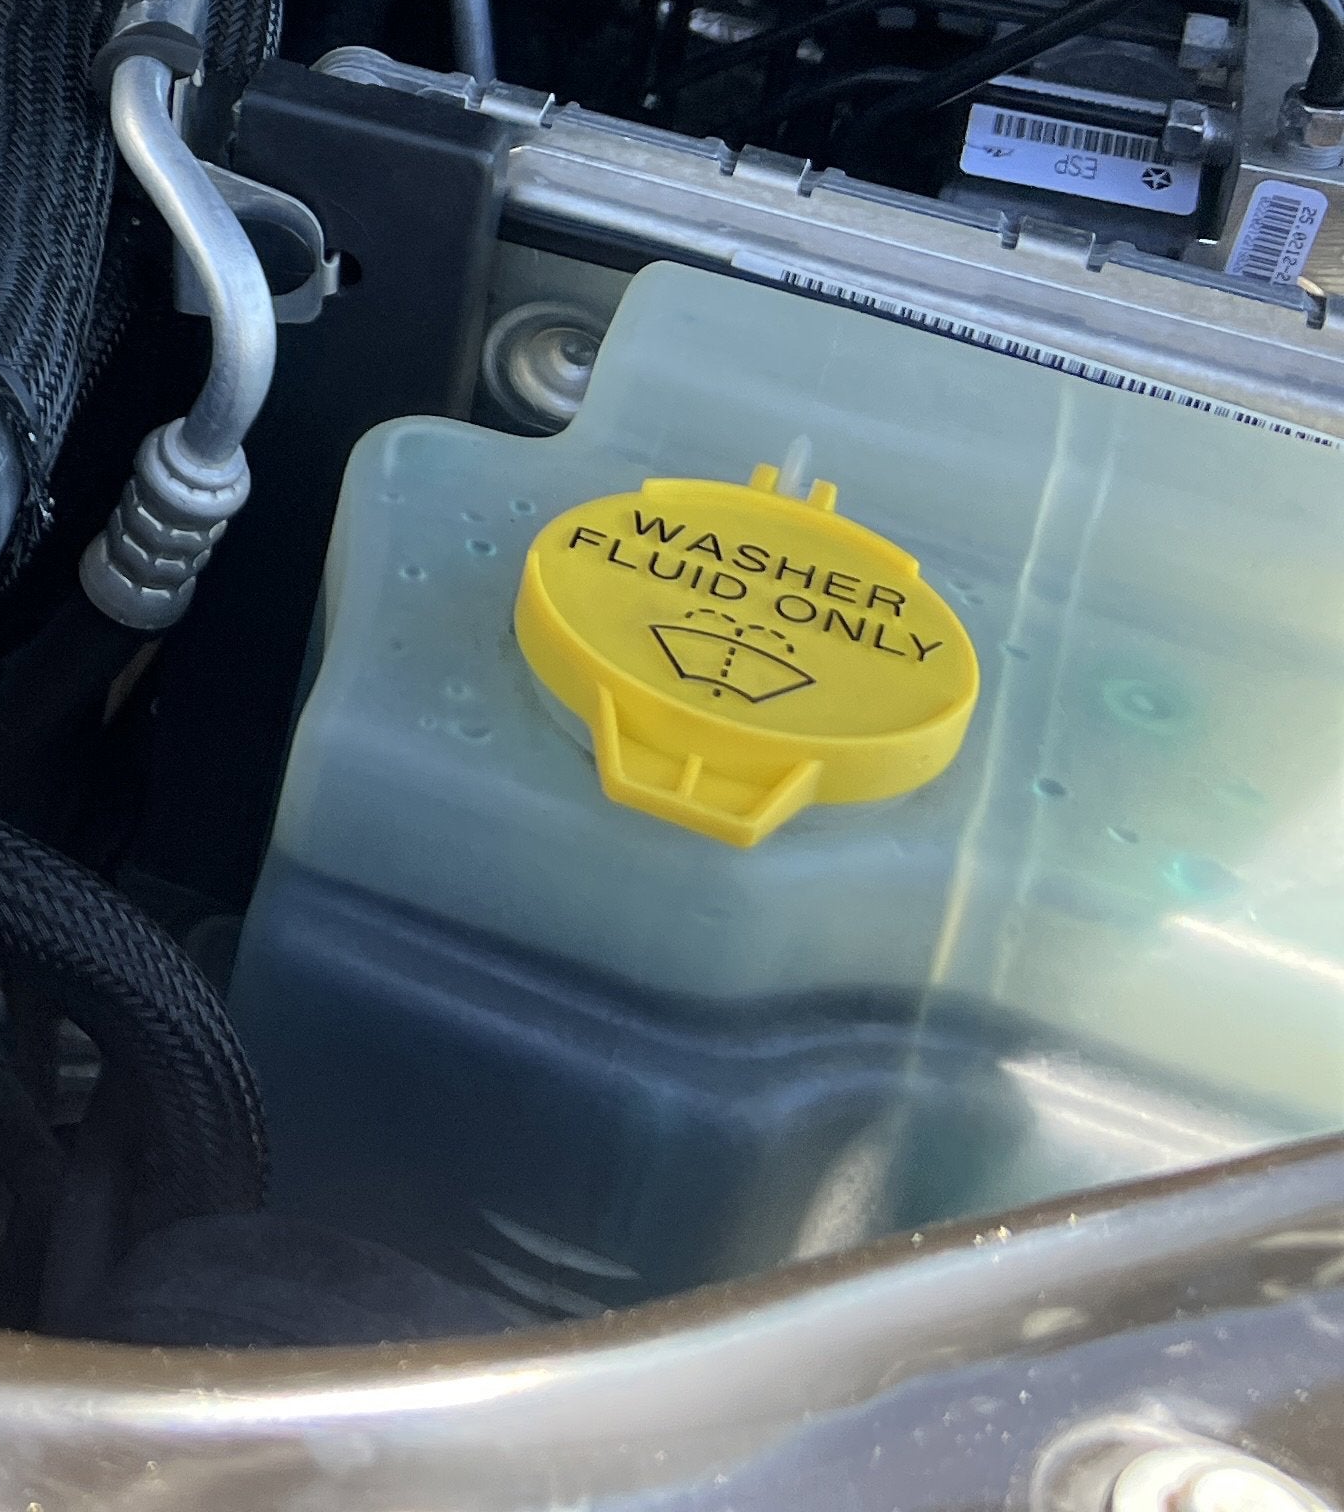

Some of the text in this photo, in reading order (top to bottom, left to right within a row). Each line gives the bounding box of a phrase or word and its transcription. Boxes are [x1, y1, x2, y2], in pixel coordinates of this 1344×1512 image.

[1055, 152, 1098, 180] ESP
[567, 526, 943, 663] FLUID ONLY
[632, 508, 907, 617] WASHER
